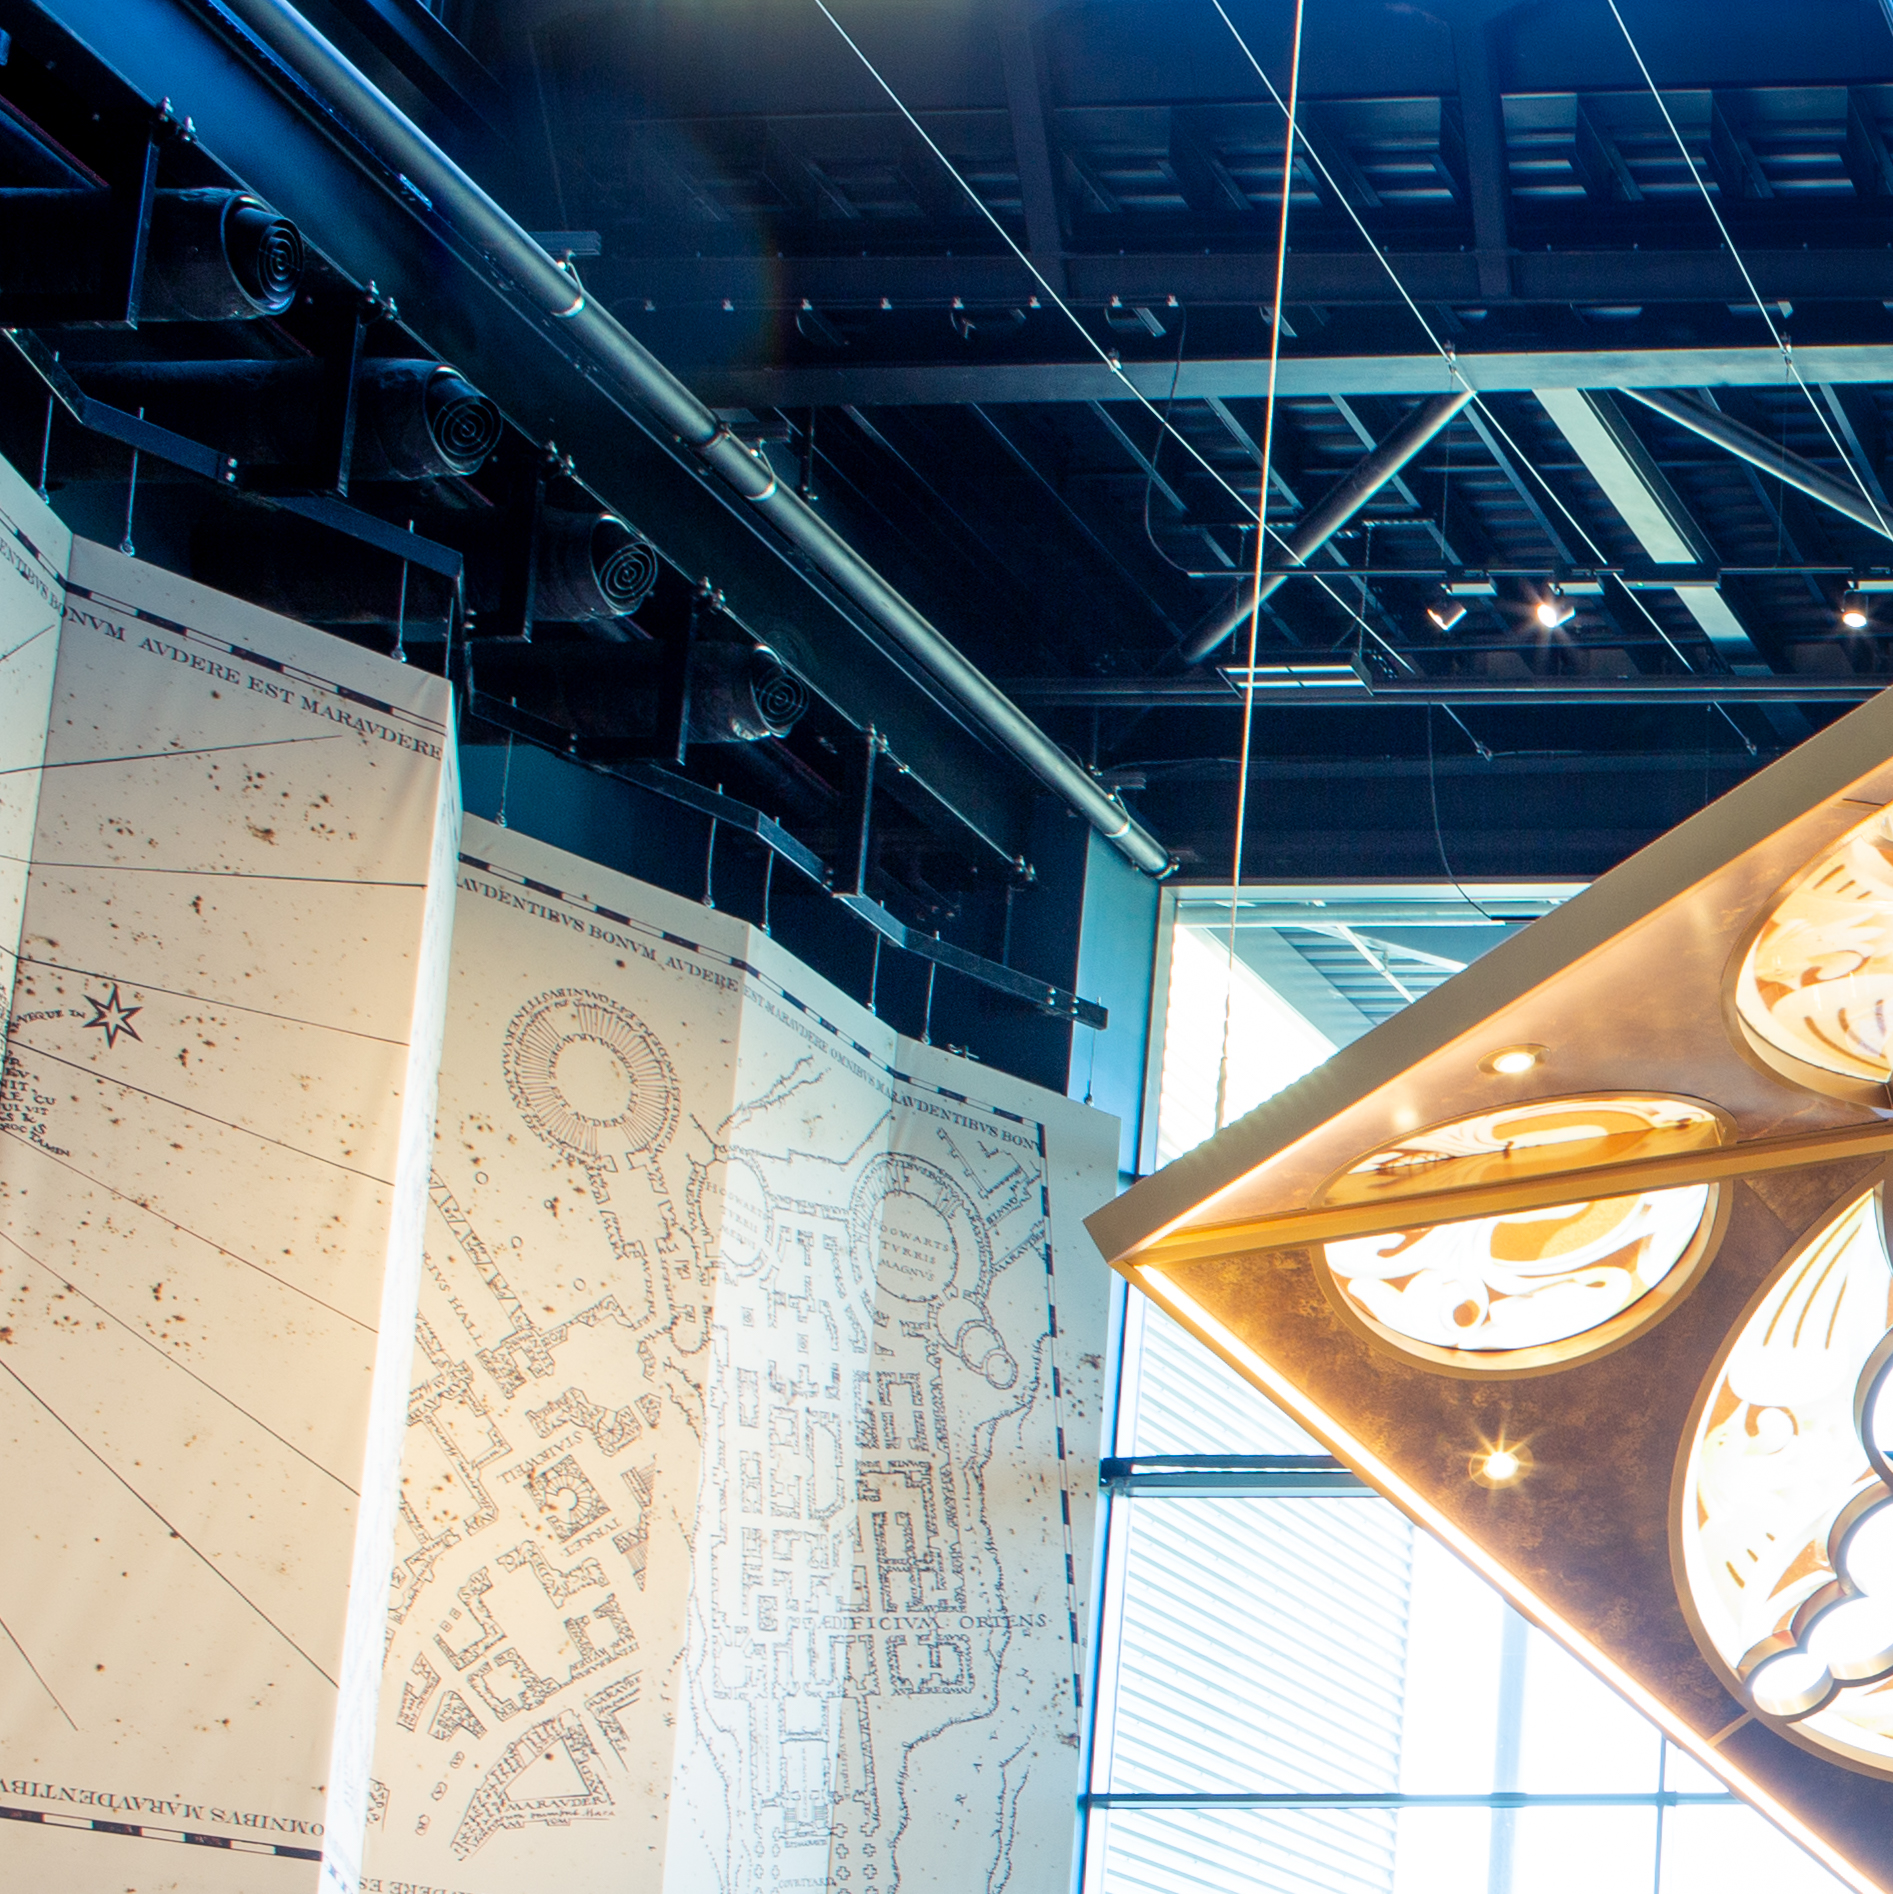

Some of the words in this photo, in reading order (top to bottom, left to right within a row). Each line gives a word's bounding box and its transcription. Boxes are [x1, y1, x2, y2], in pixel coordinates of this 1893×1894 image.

[50, 592, 125, 642] BONVM
[138, 637, 241, 685] AVDERE
[247, 675, 295, 705] EST
[301, 695, 443, 761] MARAVDERE
[589, 924, 656, 962] BONVM
[665, 956, 739, 993] AVDERE
[496, 1431, 584, 1484] STAIRWELL
[958, 1613, 1049, 1631] ORIENS
[210, 1807, 325, 1836] OMNIBVS
